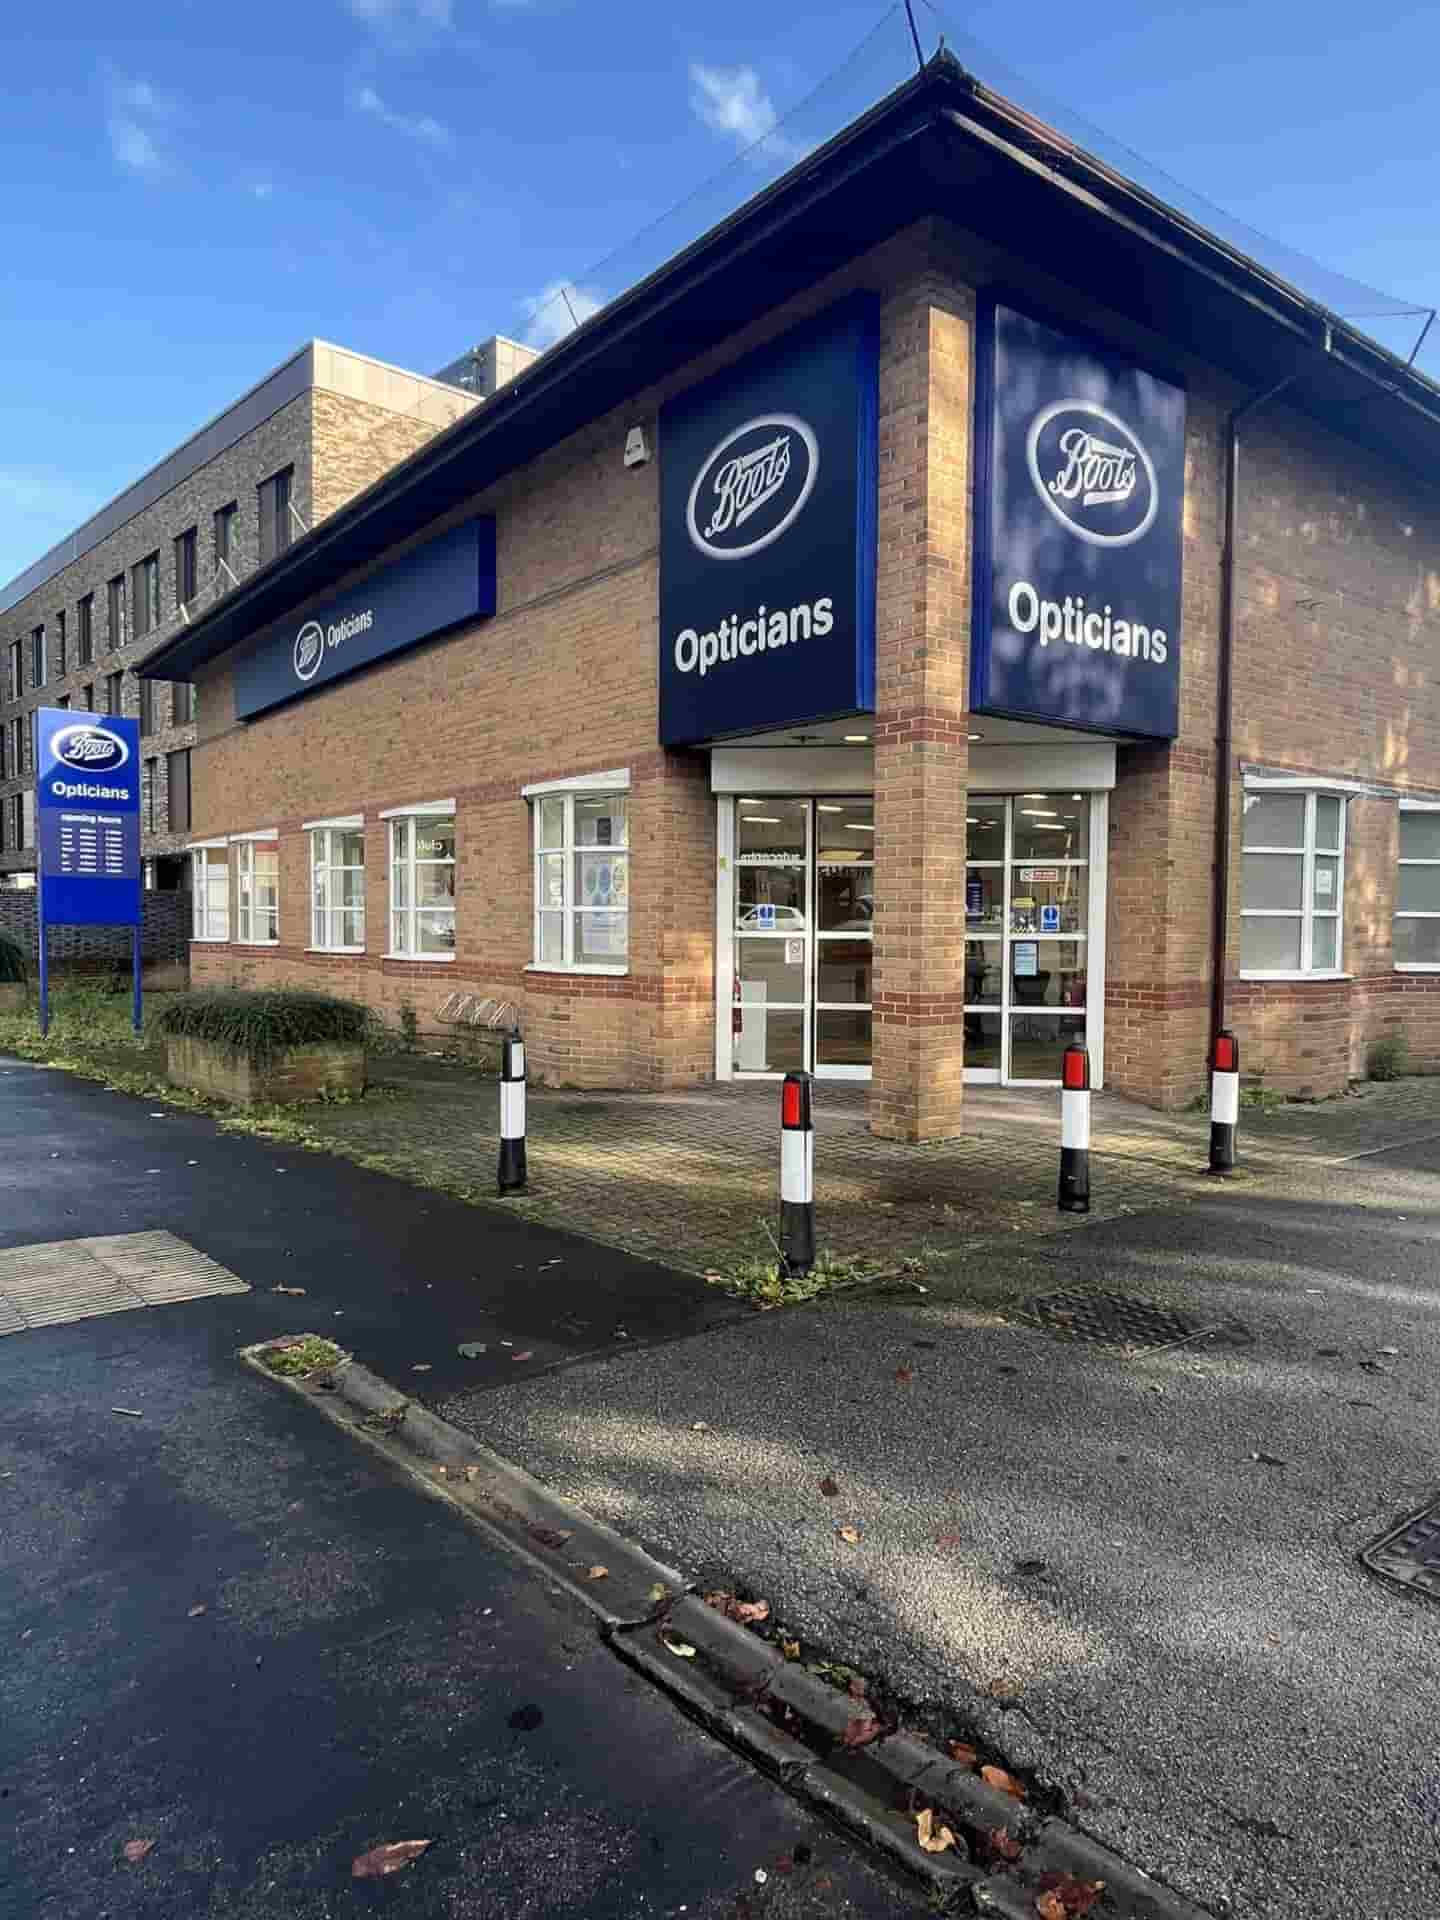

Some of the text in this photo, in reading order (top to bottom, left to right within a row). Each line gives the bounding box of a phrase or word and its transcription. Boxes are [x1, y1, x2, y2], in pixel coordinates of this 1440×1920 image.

[705, 435, 790, 537] Boots
[1049, 429, 1137, 505] Boots
[328, 610, 373, 648] Opticians
[675, 597, 833, 674] Opticians
[1008, 582, 1168, 663] Opticians
[52, 782, 129, 799] Opticians
